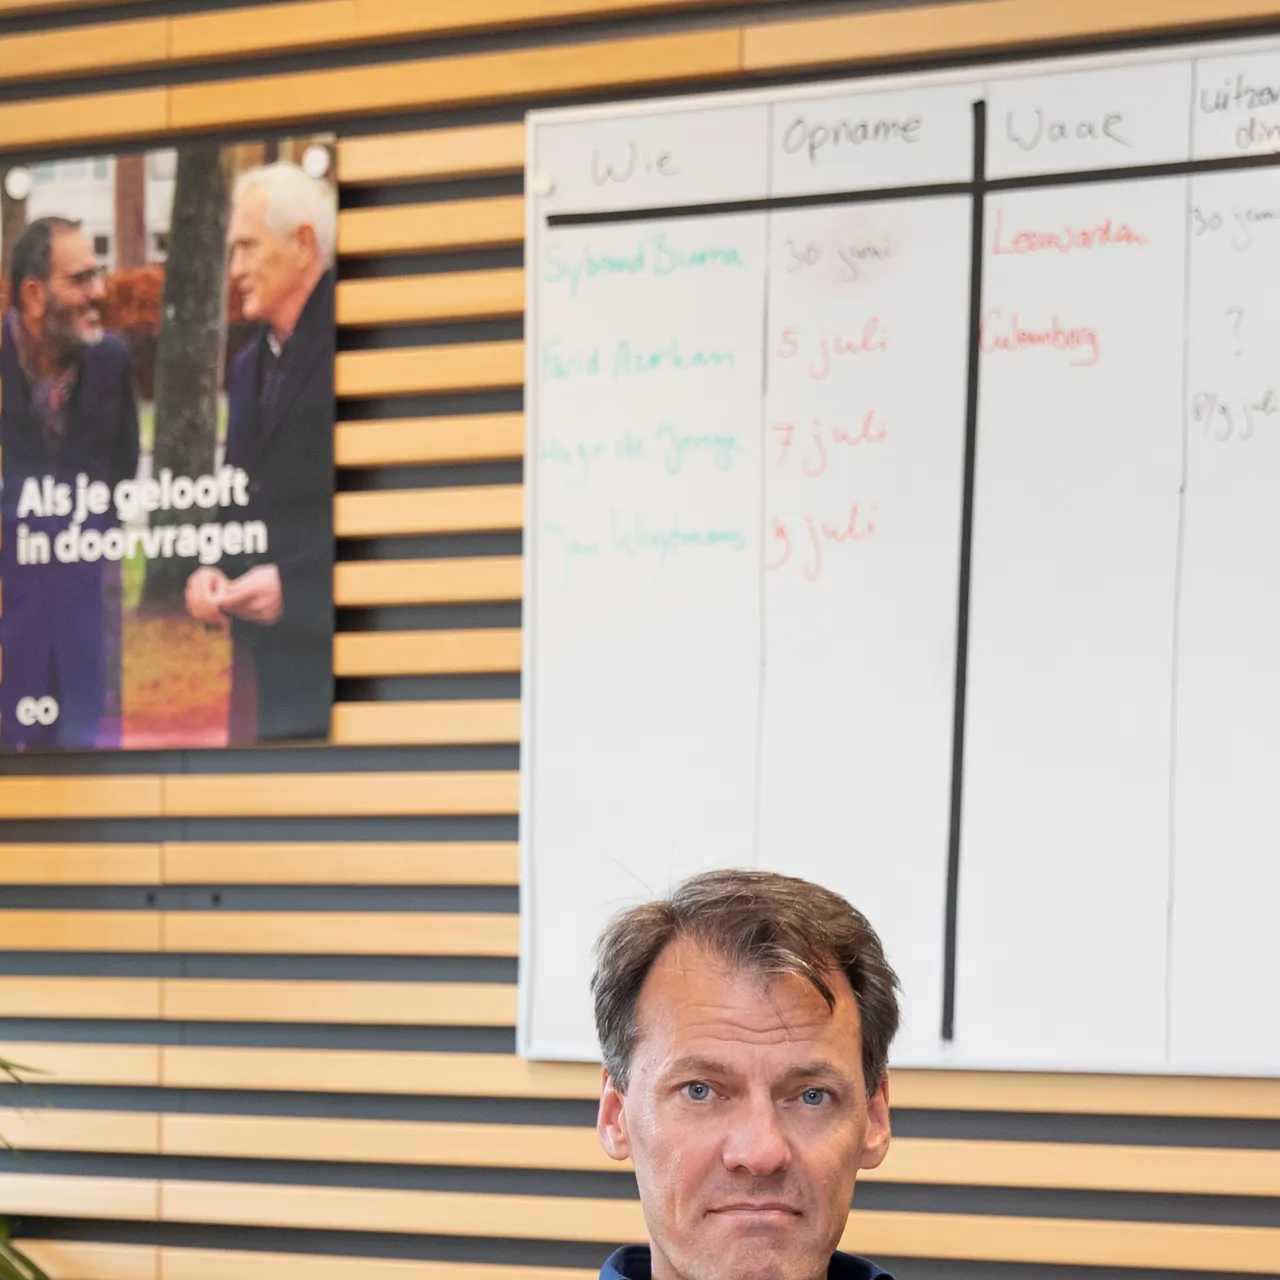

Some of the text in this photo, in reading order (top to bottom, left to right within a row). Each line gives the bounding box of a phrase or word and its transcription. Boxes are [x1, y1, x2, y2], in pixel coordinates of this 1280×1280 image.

[591, 139, 681, 187] Wie
[781, 115, 923, 166] Opname
[775, 314, 889, 380] 5 juli
[1224, 306, 1246, 357] ?
[771, 409, 888, 478] 7 juli
[18, 466, 250, 523] Als je gelooft
[17, 521, 268, 565] in doorvragen
[801, 502, 878, 581] juli
[17, 696, 59, 726] eo
